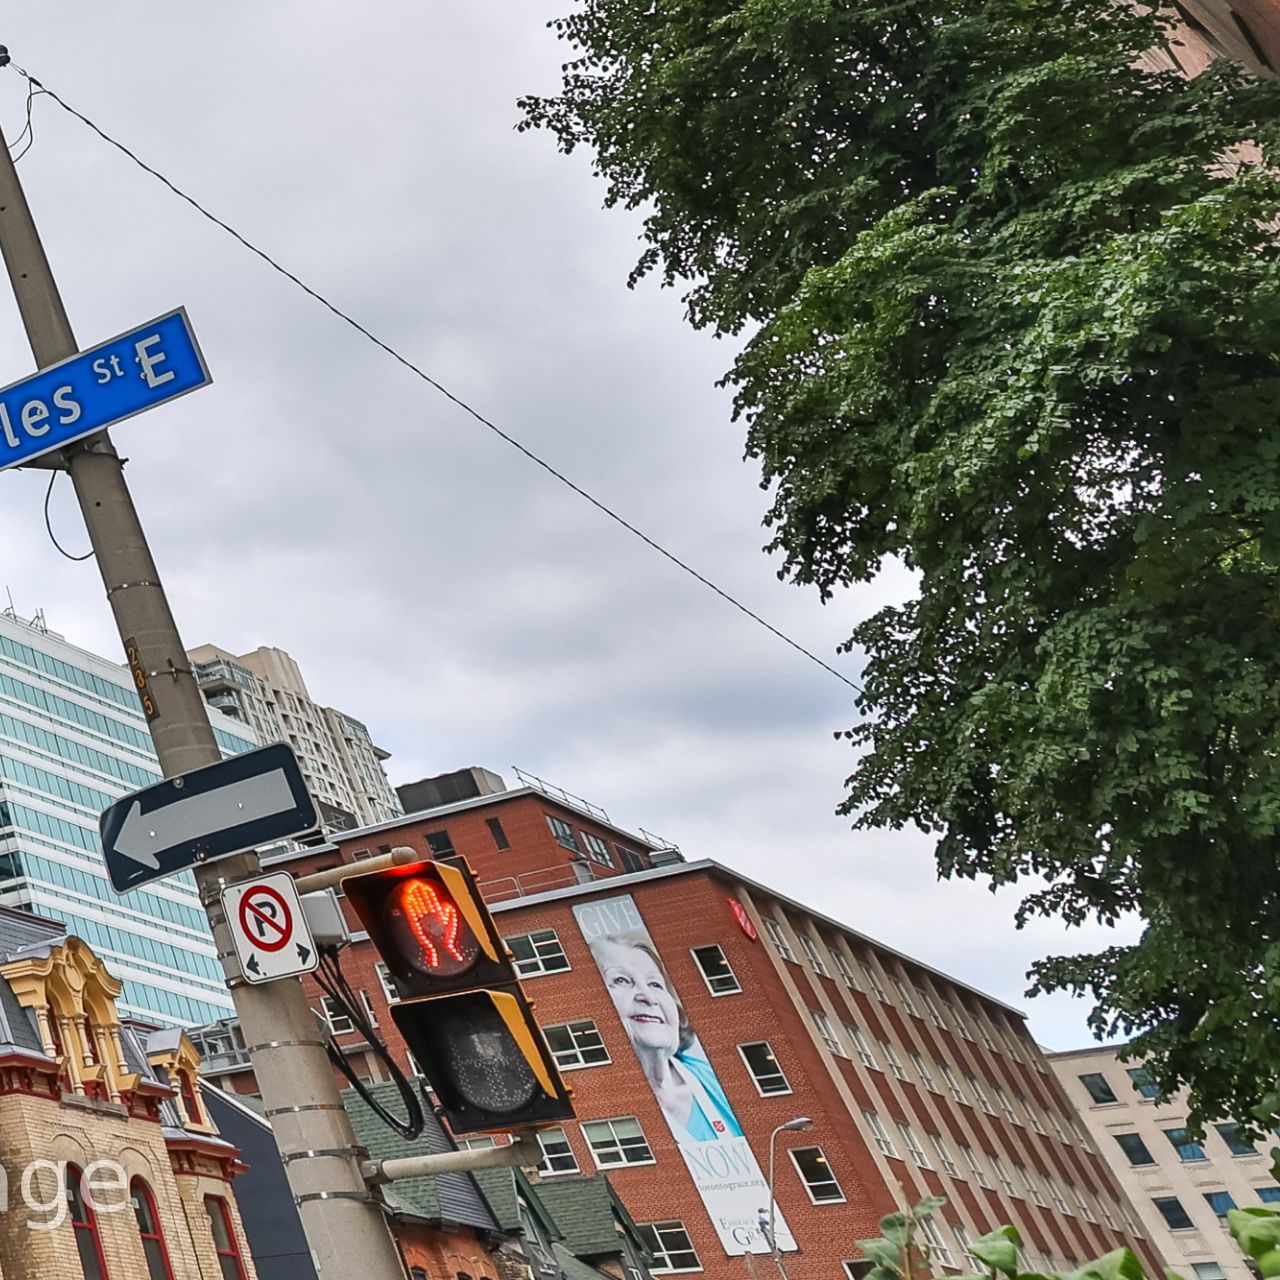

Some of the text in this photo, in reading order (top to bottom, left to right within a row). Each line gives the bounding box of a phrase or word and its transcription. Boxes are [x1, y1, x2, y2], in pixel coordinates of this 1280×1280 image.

[93, 353, 124, 385] St
[134, 333, 175, 389] E
[579, 901, 641, 937] GIVE
[685, 1142, 752, 1180] NOW
